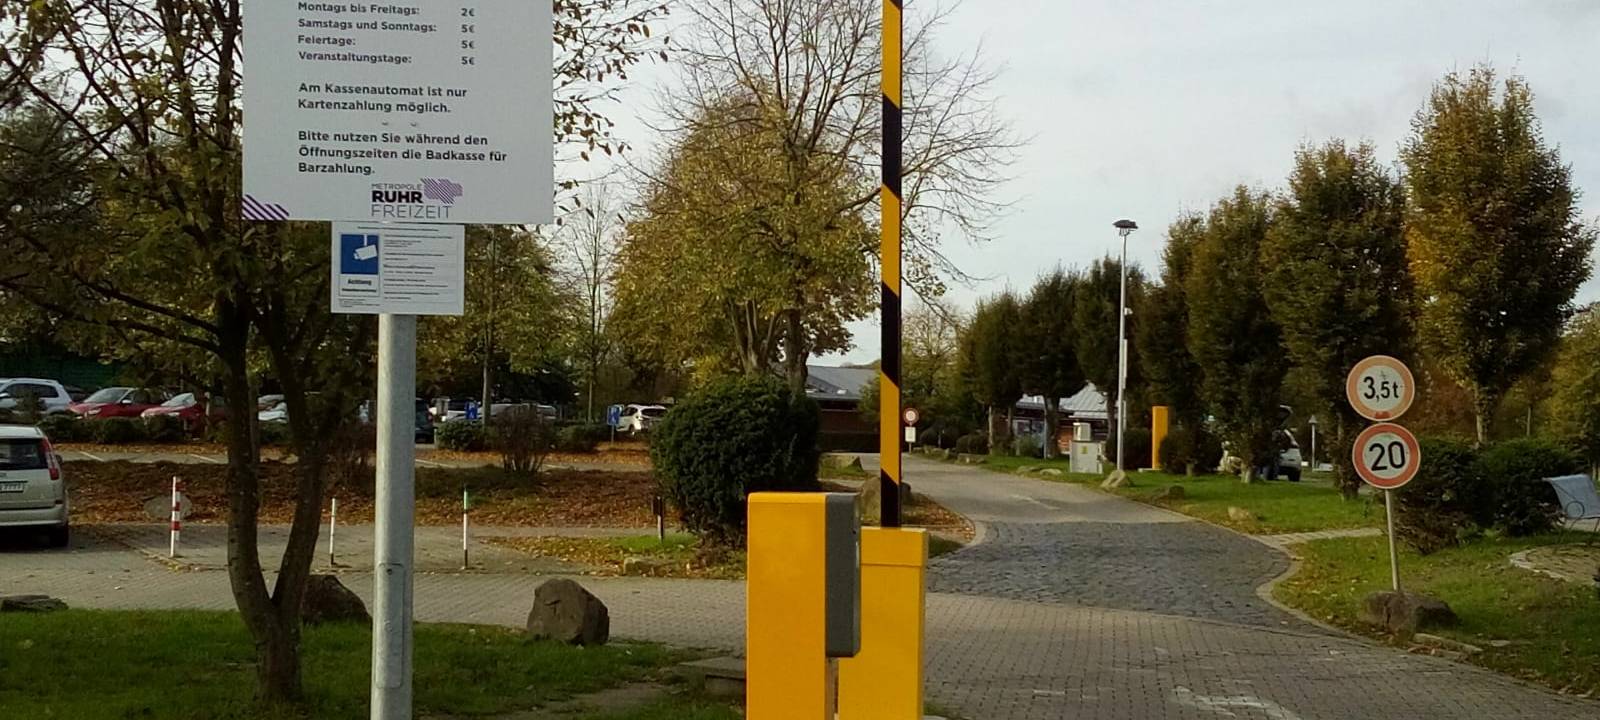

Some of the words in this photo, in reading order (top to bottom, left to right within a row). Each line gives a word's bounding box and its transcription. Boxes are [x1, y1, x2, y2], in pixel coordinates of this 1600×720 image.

[297, 1, 347, 14] Montags
[350, 3, 367, 13] bis
[370, 4, 420, 17] Freitags:
[460, 7, 475, 17] 2€
[297, 18, 354, 31] Samstags
[355, 20, 378, 31] und
[381, 21, 437, 33] Sonntags:
[460, 24, 475, 34] 5€
[297, 34, 356, 47] Feiertage:
[460, 39, 475, 50] 5€
[298, 51, 412, 65] Veranstaltungstage:
[460, 55, 475, 66] 5€
[298, 82, 321, 93] Am
[324, 83, 424, 97] Kassenautomat
[427, 86, 443, 97] ist
[446, 88, 468, 98] nur
[297, 98, 392, 113] Kartenzahlung
[395, 101, 452, 115] möglich.
[297, 130, 330, 142] Bitte
[333, 132, 378, 143] nutzen
[381, 134, 401, 144] Sie
[405, 134, 461, 145] während
[463, 135, 489, 146] den
[298, 145, 399, 160] Öffnungszeiten
[401, 149, 422, 160] die
[425, 150, 486, 162] Badkasse
[489, 151, 508, 162] für
[297, 161, 376, 176] Barzahlung.
[371, 183, 423, 191] METROPOLE
[372, 190, 424, 204] RUHR
[371, 204, 453, 219] FREIZEIT
[1368, 440, 1407, 472] 20
